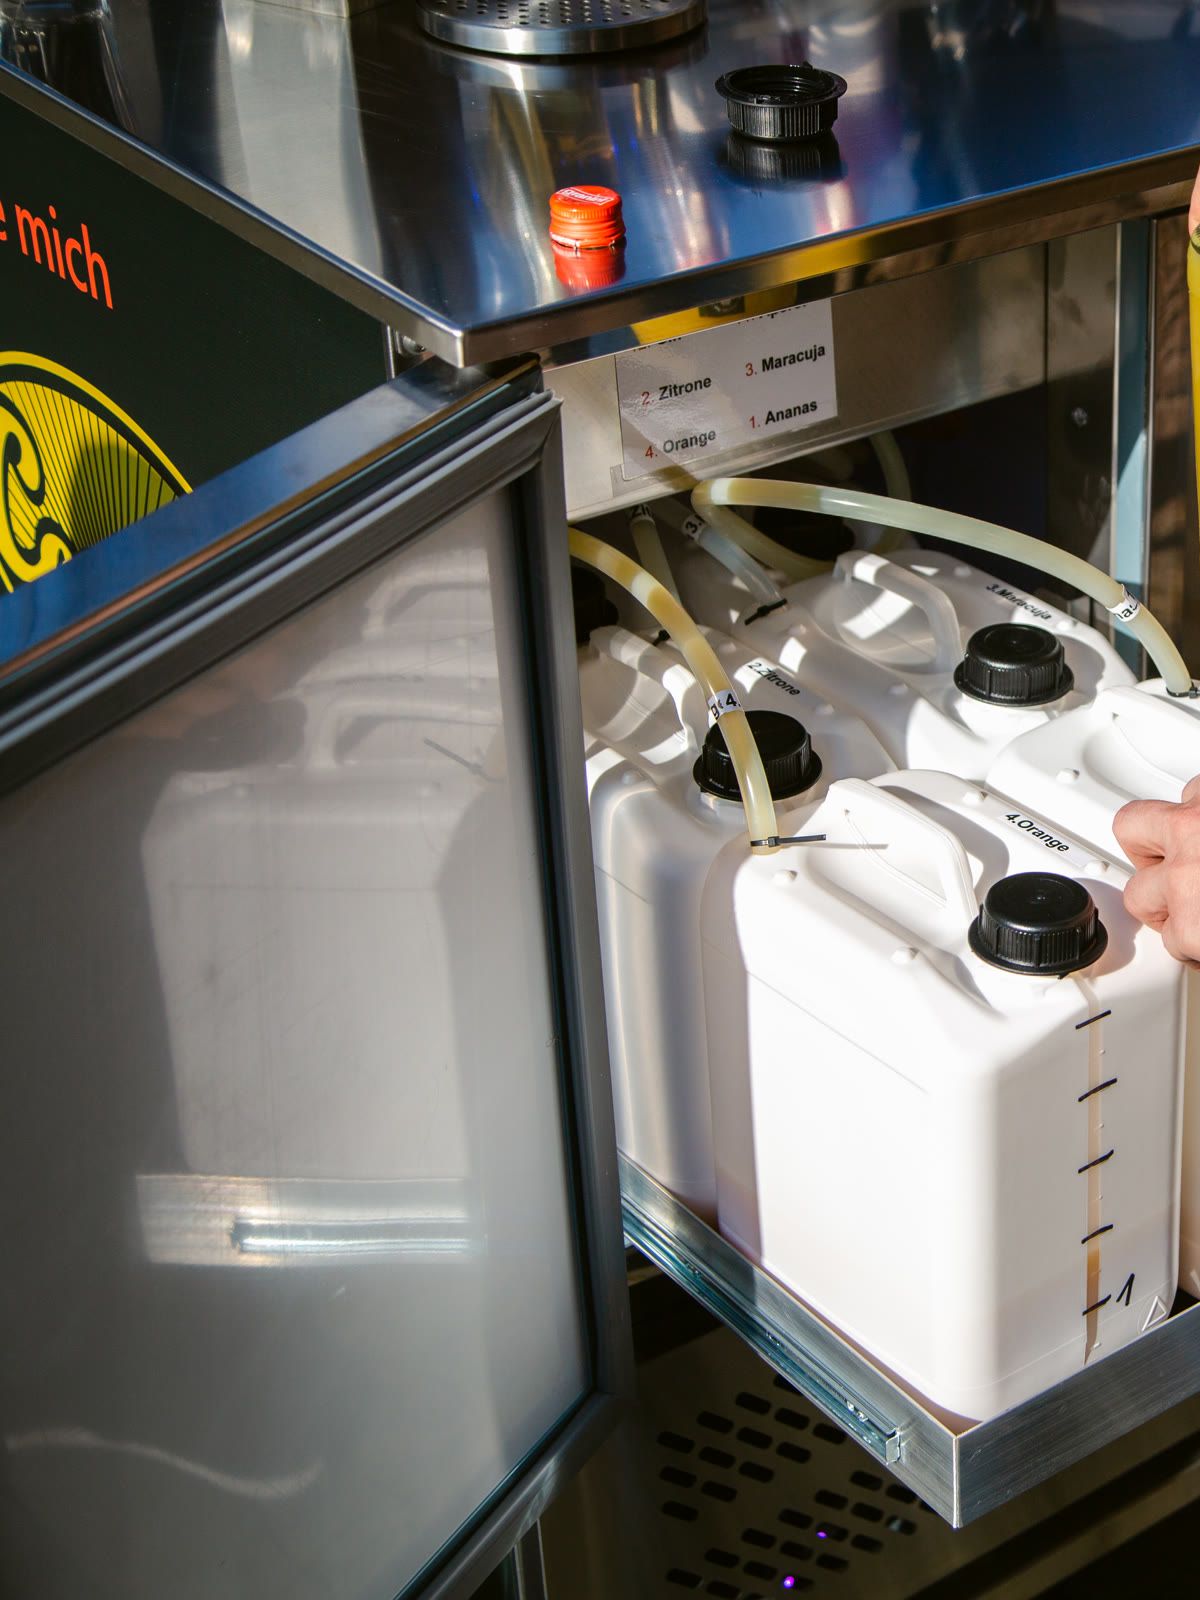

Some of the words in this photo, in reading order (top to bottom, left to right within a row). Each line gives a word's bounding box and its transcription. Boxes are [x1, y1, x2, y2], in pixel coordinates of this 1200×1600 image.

[15, 204, 113, 309] mich
[745, 362, 758, 377] 3.
[761, 344, 826, 373] Maracuja
[641, 391, 655, 406] 2.
[658, 376, 712, 401] Zitrone
[749, 416, 761, 429] 1.
[765, 400, 818, 425] Ananas
[645, 446, 659, 459] 4.
[662, 430, 717, 454] Orange
[986, 583, 1052, 620] 3.Maracuja
[748, 661, 800, 696] 2.Zitrone
[1005, 813, 1069, 851] 4.Orange
[1115, 1272, 1135, 1306] 1
